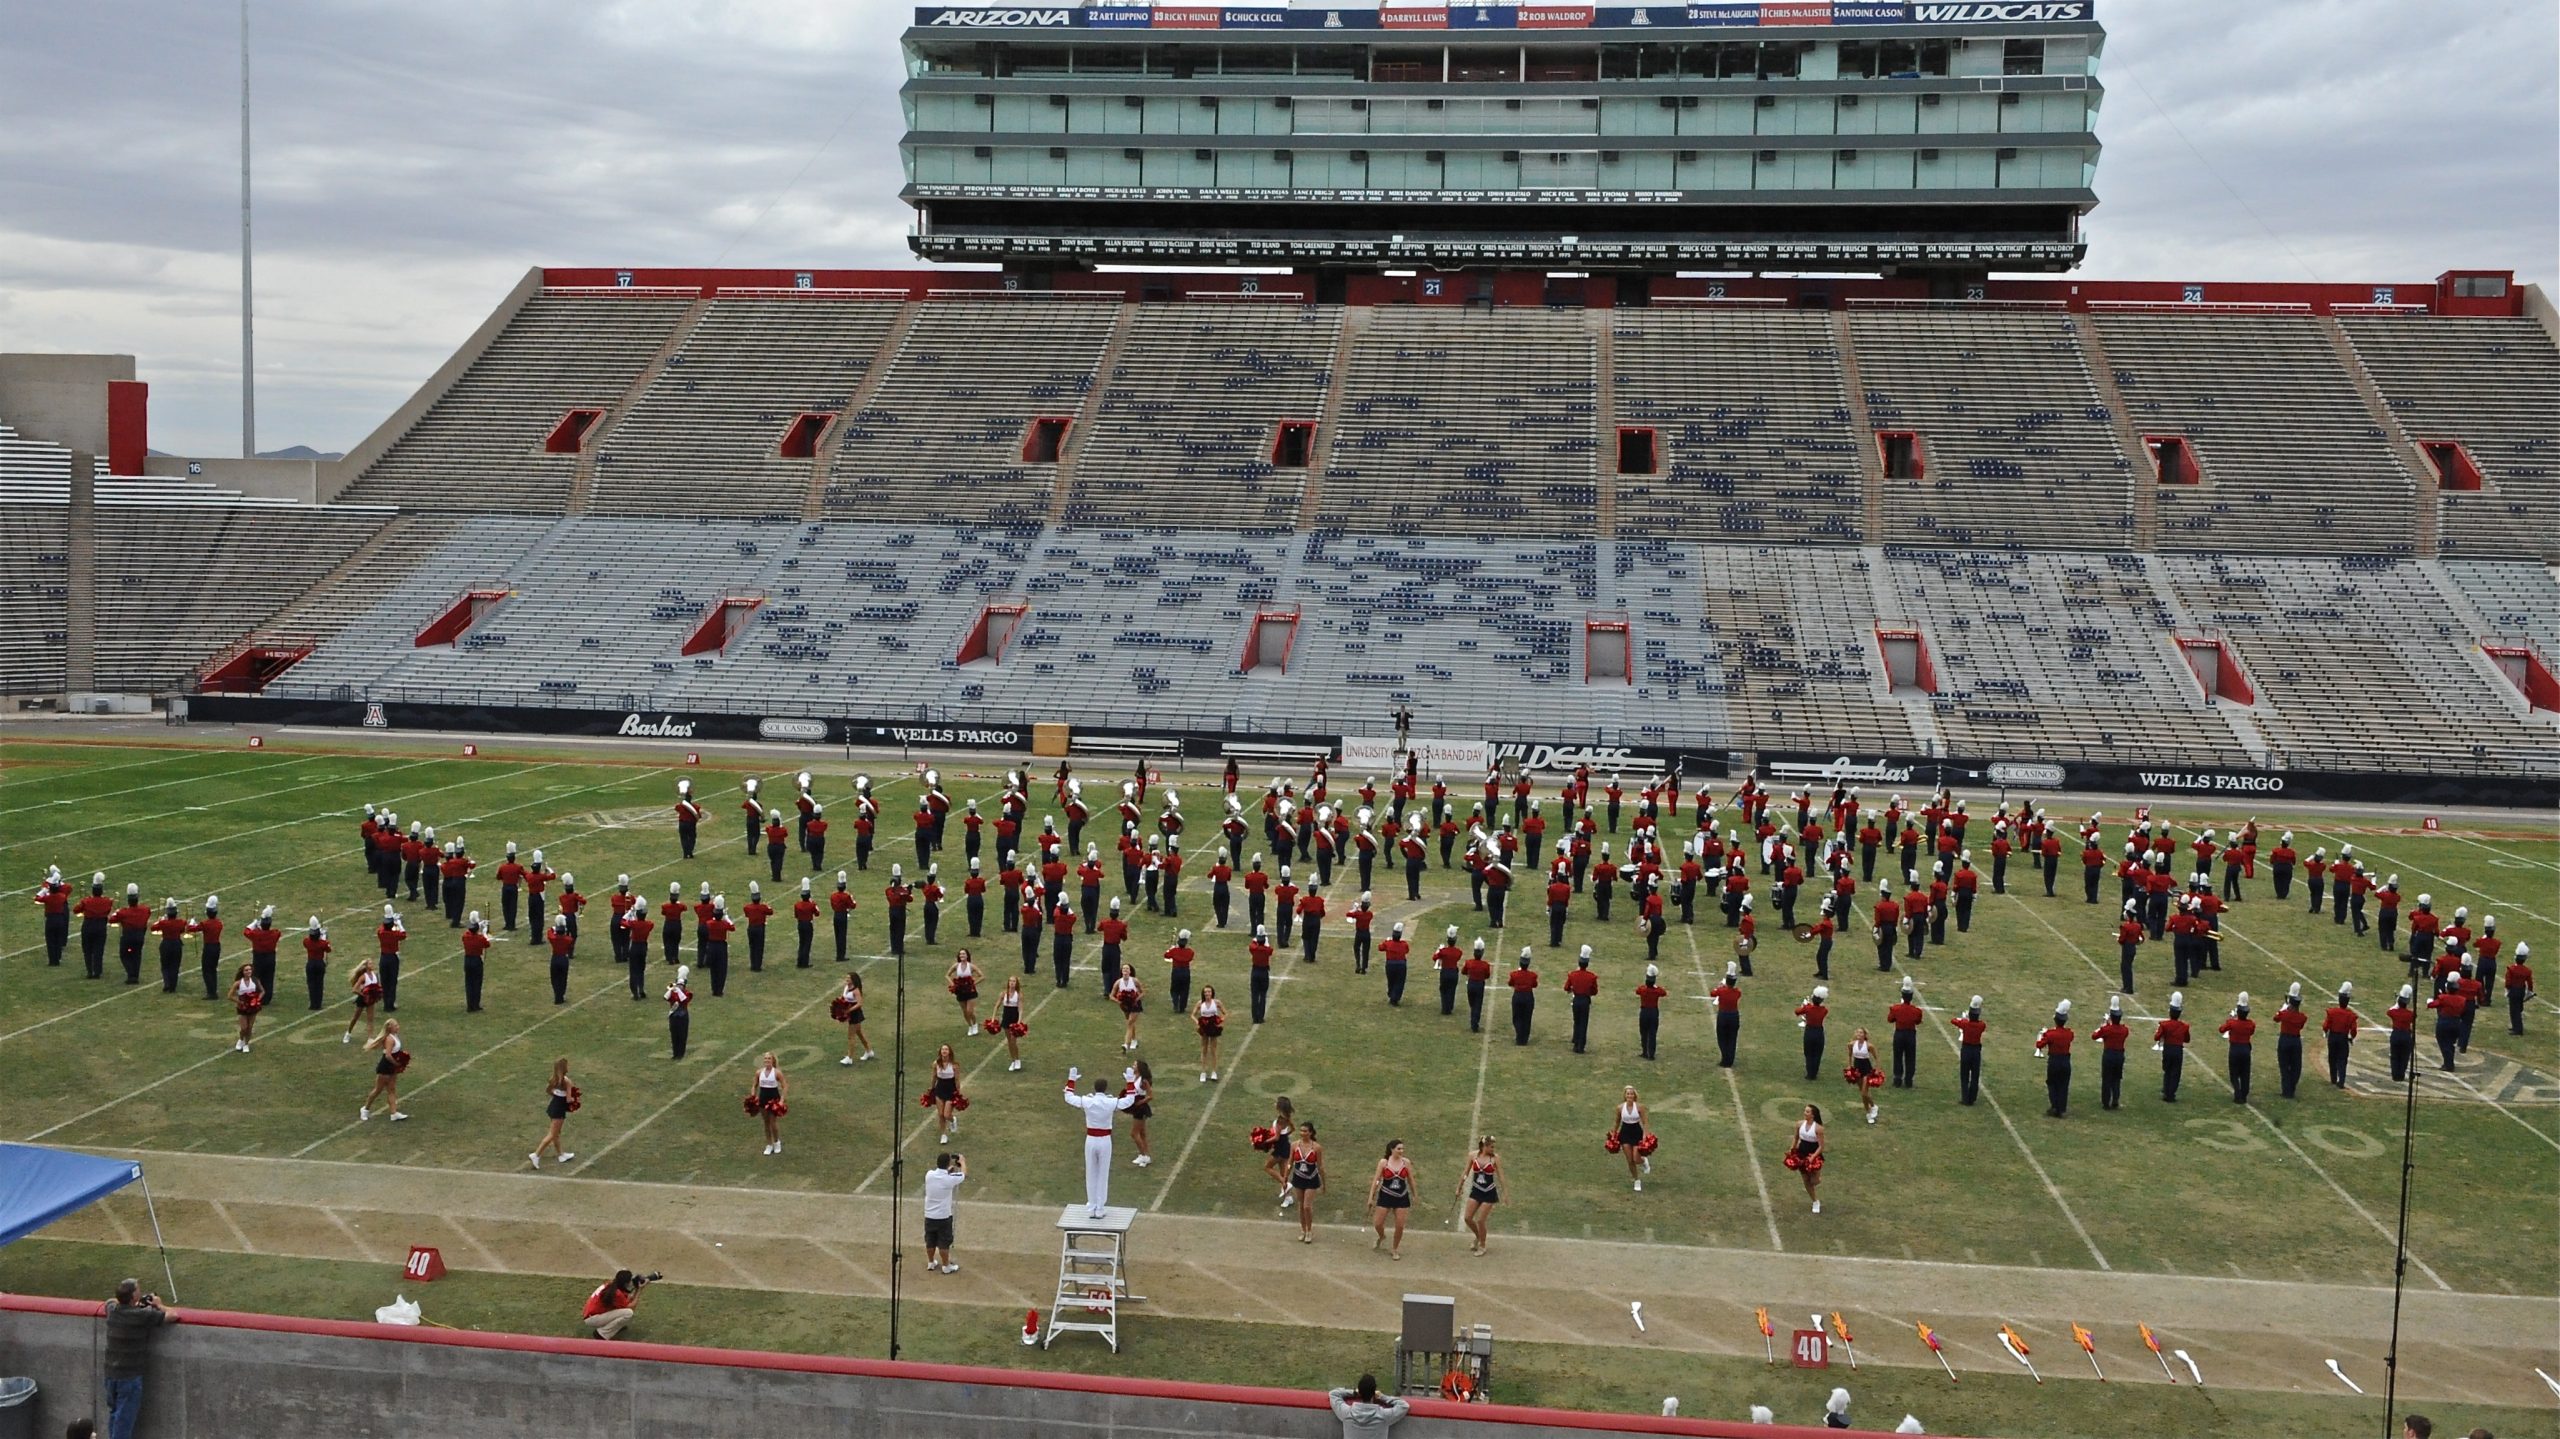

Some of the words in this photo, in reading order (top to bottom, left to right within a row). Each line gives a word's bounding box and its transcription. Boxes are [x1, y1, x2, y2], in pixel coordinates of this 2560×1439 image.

[1089, 12, 1098, 21] 22
[1225, 13, 1231, 21] 6
[1518, 12, 1528, 20] 92
[1718, 10, 1759, 18] McLAUGHLIN
[1761, 8, 1767, 17] 11
[1792, 9, 1831, 17] McALISTER
[1834, 8, 1839, 17] 5
[1840, 9, 1874, 17] ANTOINE
[1875, 9, 1902, 17] CASON
[1915, 4, 2084, 21] WILDCATS
[931, 10, 1069, 26] ARIZONA
[1380, 14, 1386, 22] 4
[619, 277, 630, 287] 17
[798, 278, 810, 288] 18
[1004, 280, 1017, 290] 19
[1242, 282, 1257, 293] 20
[1426, 284, 1439, 294] 21
[1709, 287, 1724, 297] 22
[1967, 289, 1983, 300] 23
[2185, 292, 2201, 302] 24
[2375, 294, 2391, 304] 25
[190, 463, 200, 474] 16
[618, 714, 696, 736] Bashas'
[892, 728, 953, 742] WELLS
[958, 730, 1018, 743] FARGO
[1346, 746, 1389, 758] UNIVERSITY
[1442, 749, 1464, 760] BAND
[1467, 750, 1483, 761] DAY
[2016, 770, 2057, 778] CASINOS
[2139, 773, 2210, 788] WELLS
[2215, 776, 2283, 791] FARGO
[408, 1251, 430, 1276] 40
[1798, 1336, 1821, 1362] 40
